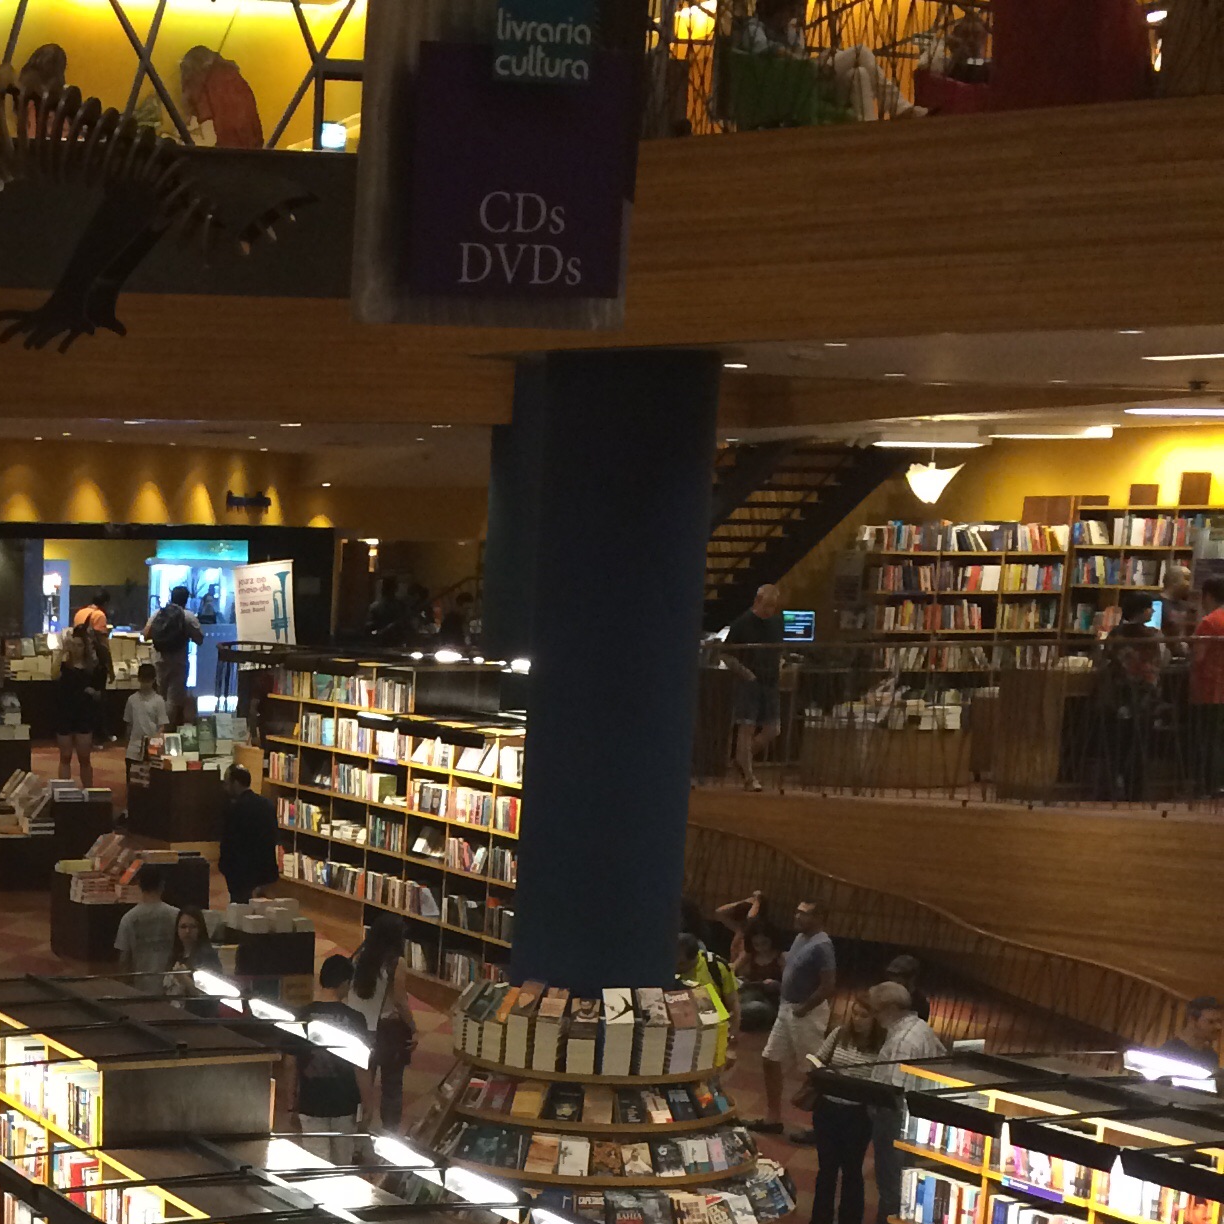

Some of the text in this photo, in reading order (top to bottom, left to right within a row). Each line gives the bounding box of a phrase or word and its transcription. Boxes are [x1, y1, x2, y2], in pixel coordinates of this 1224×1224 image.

[496, 7, 592, 46] livraria
[494, 44, 590, 81] cultura
[479, 190, 566, 235] CDs
[458, 242, 582, 286] DVDs
